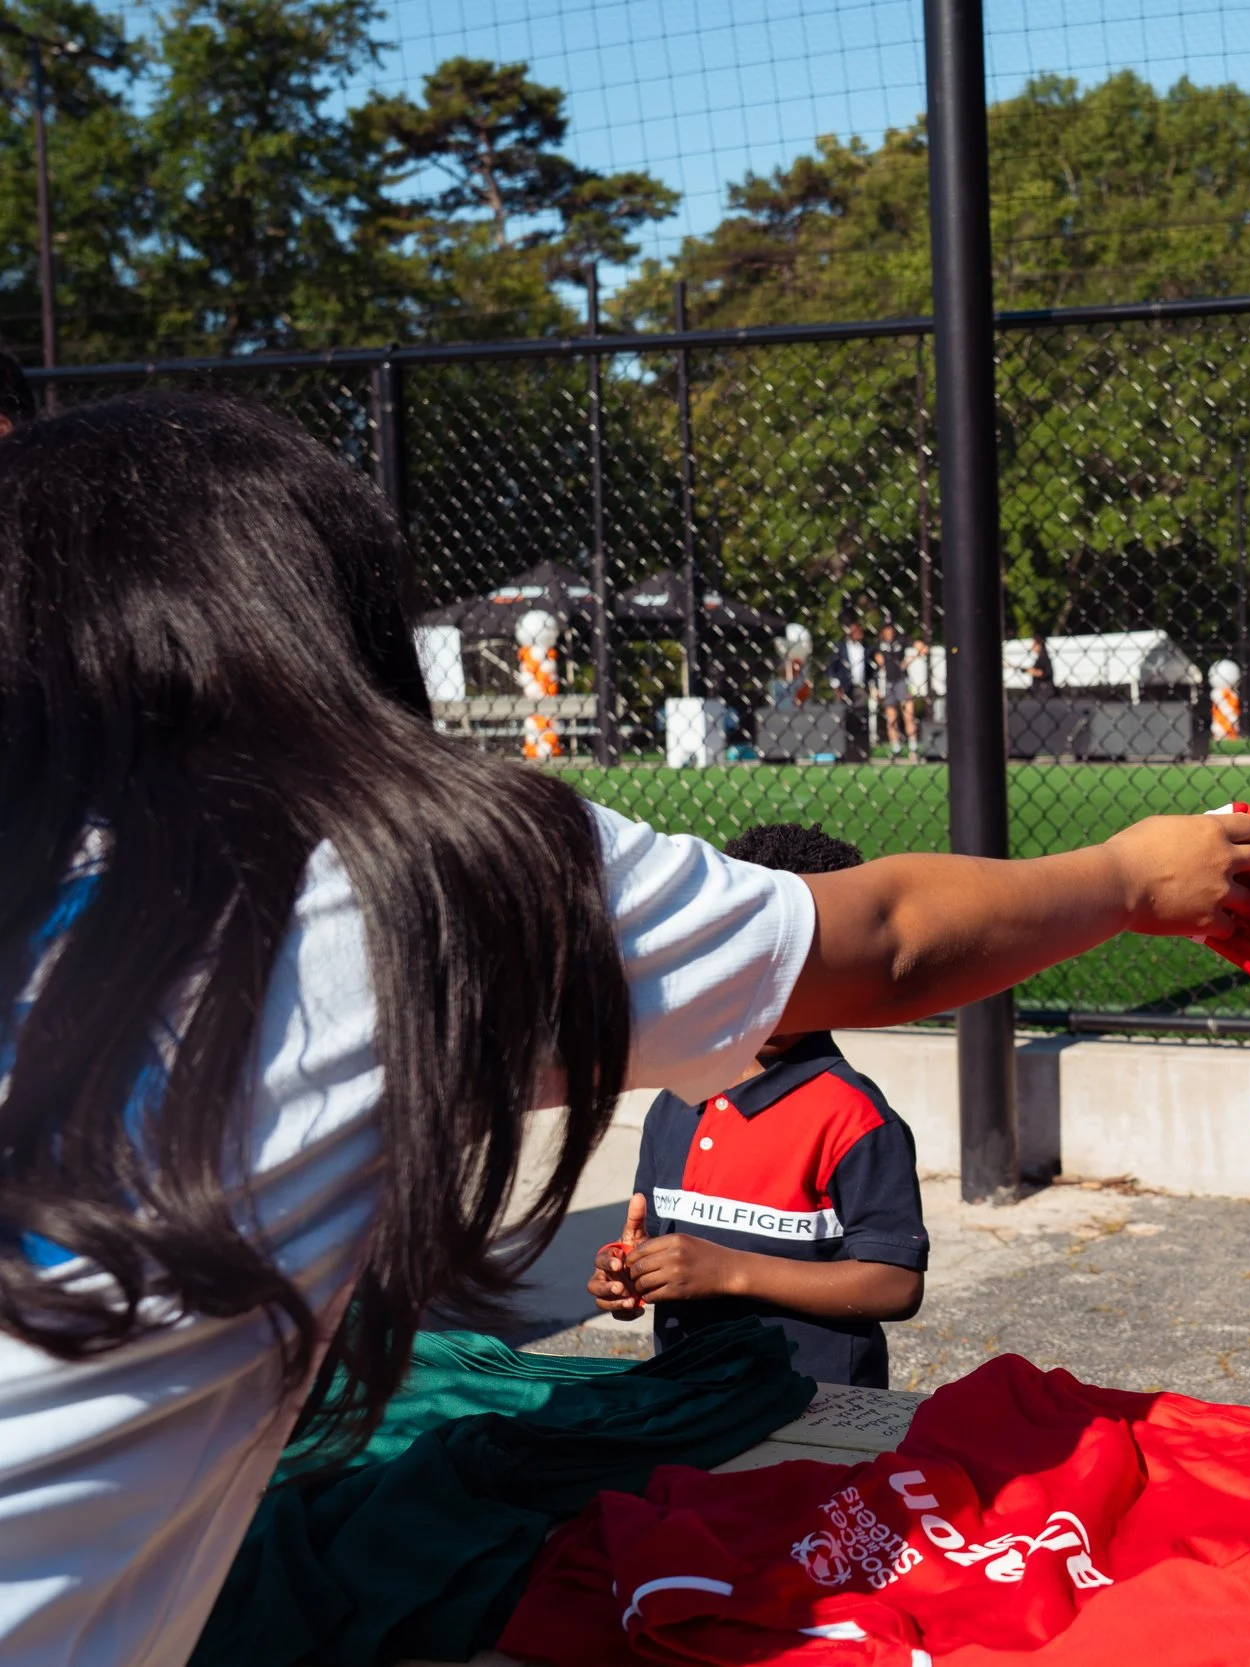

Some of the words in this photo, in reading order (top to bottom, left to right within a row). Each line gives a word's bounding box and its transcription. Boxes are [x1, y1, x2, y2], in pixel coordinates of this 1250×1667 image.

[691, 1201, 813, 1234] HILFIGER
[818, 1499, 898, 1589] Soccer
[841, 1487, 923, 1574] Streets
